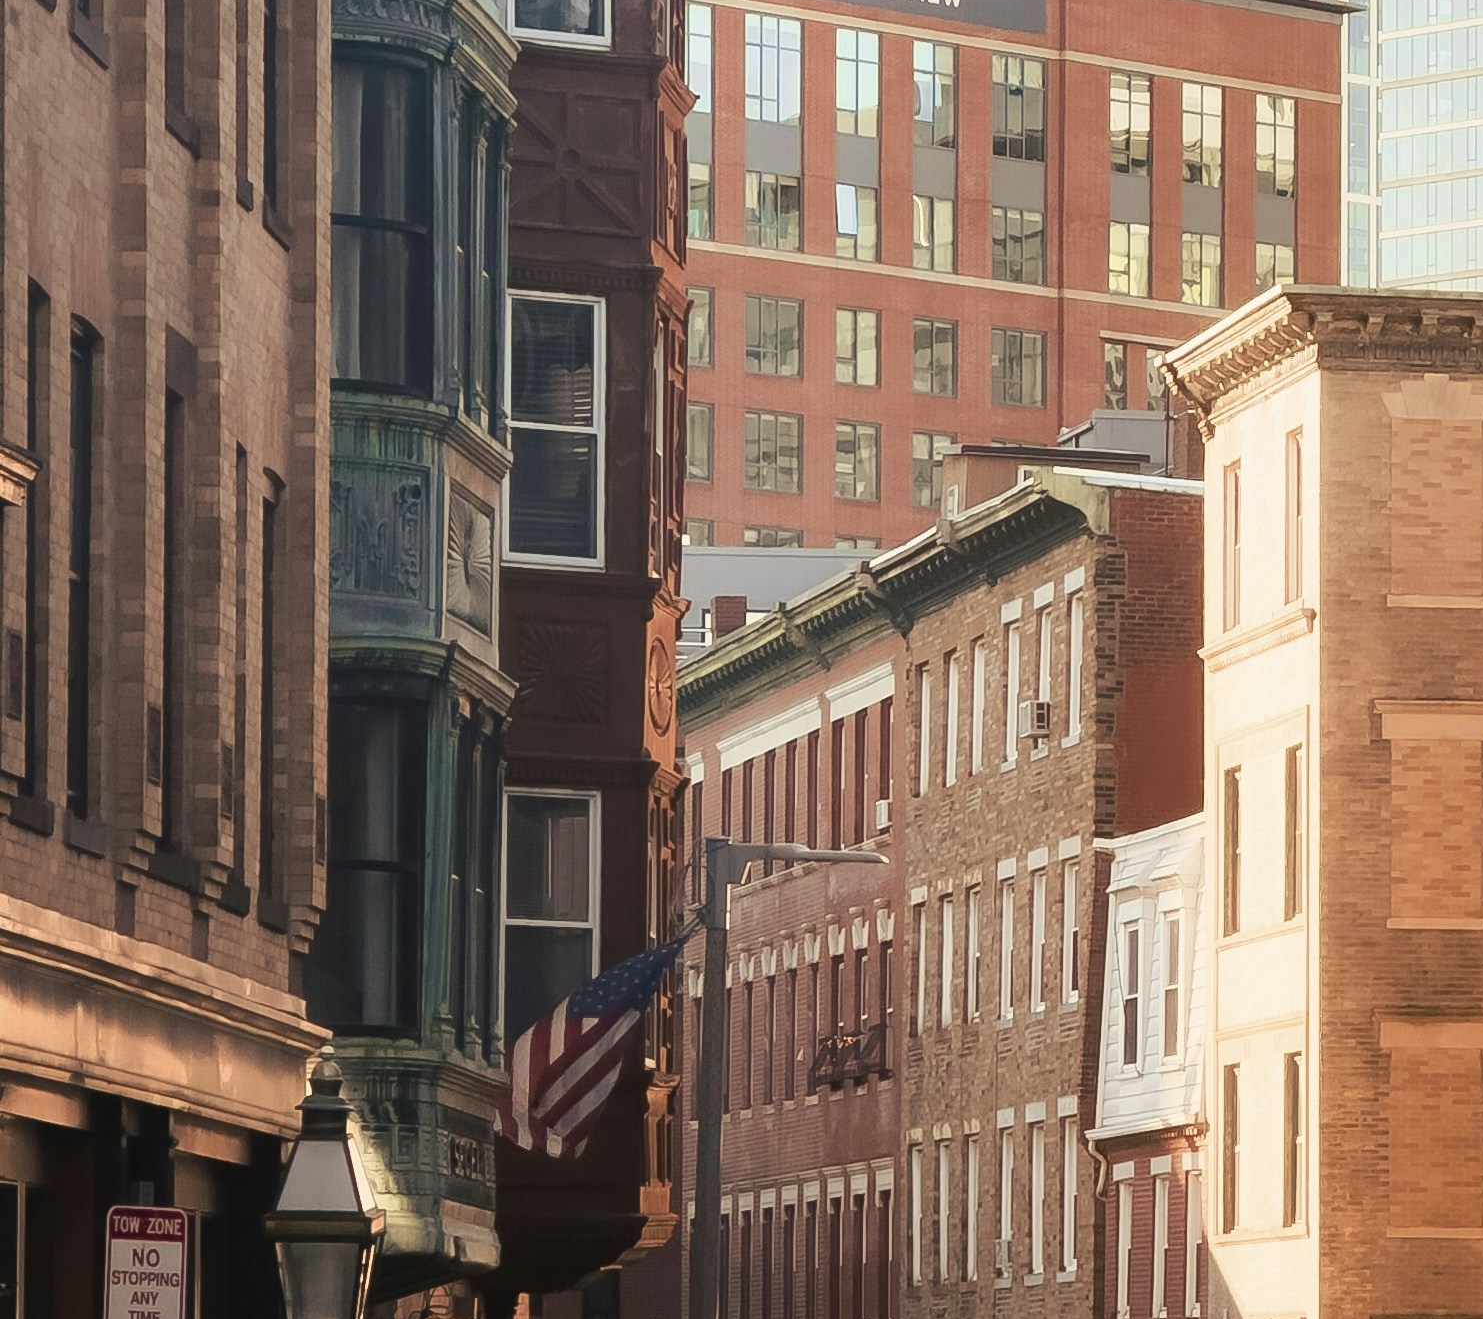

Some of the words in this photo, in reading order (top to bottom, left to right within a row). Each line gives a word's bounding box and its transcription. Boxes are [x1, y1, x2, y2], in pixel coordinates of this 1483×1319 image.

[113, 1216, 140, 1233] TOW
[147, 1217, 182, 1236] ZONE
[132, 1248, 160, 1267] NO
[111, 1270, 180, 1287] STOPPING
[130, 1291, 159, 1306] ANY
